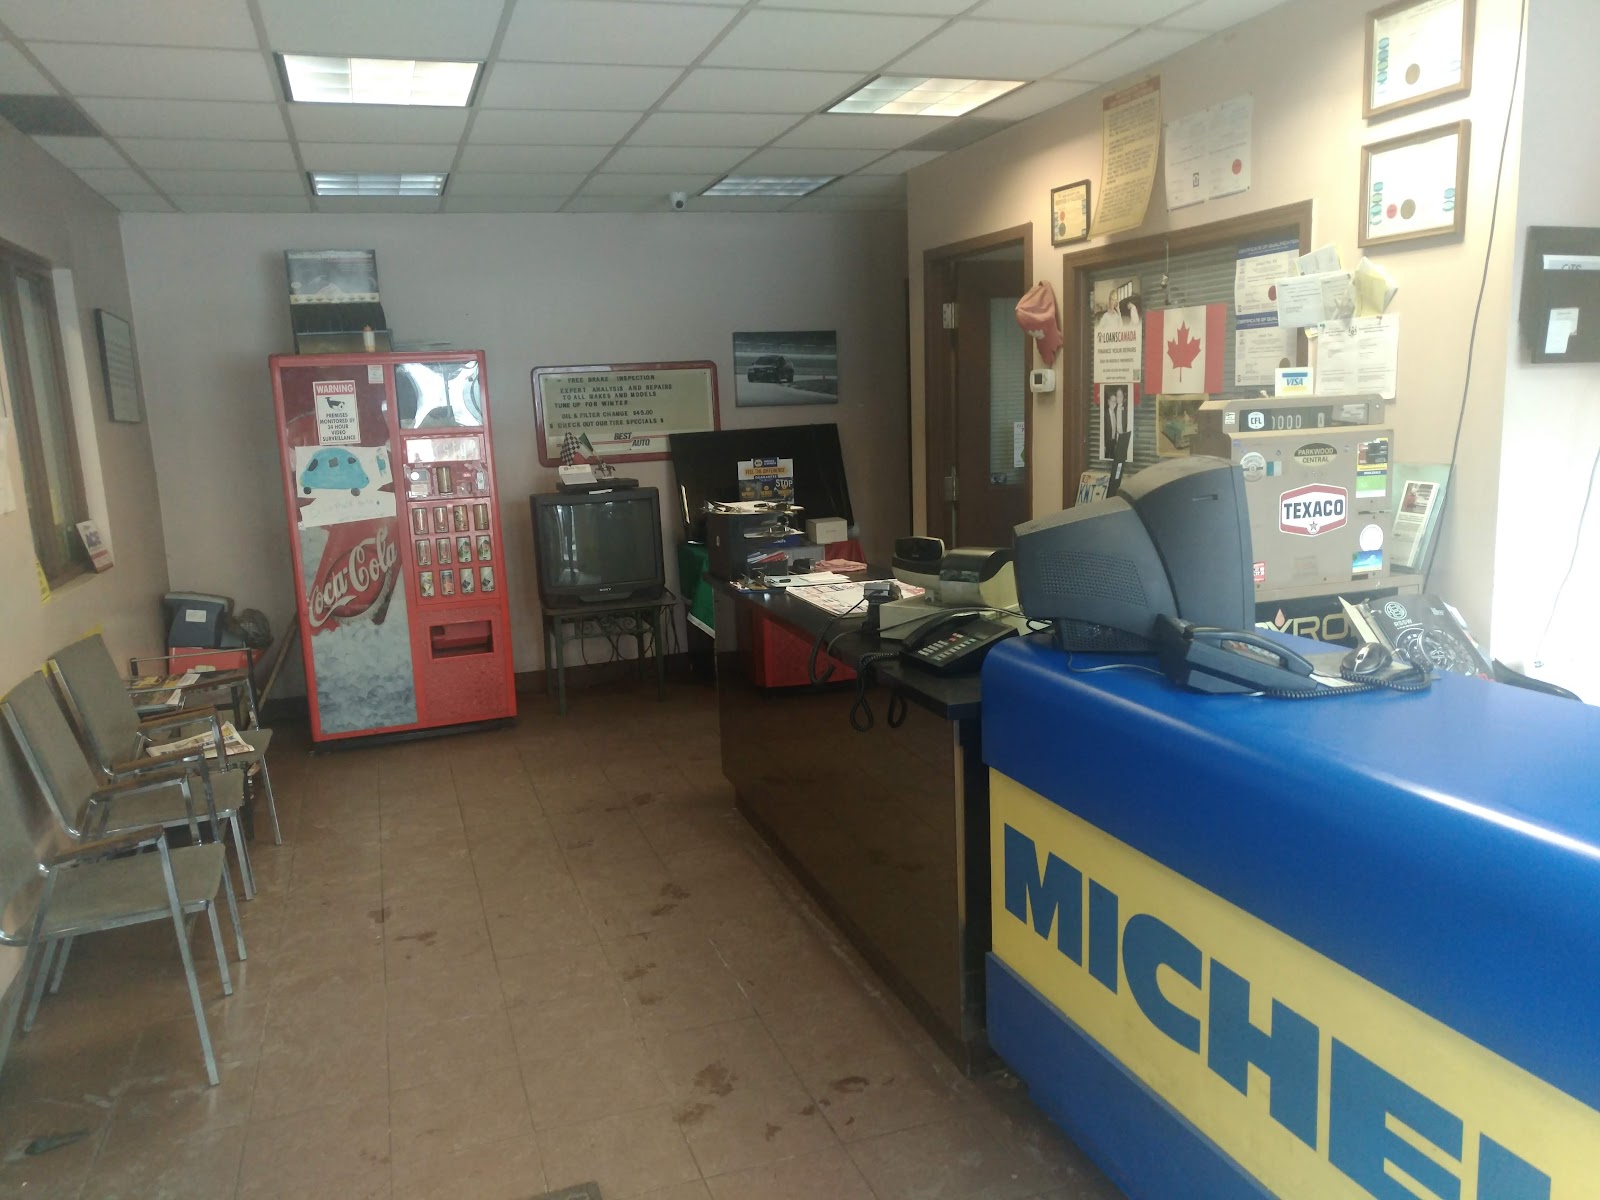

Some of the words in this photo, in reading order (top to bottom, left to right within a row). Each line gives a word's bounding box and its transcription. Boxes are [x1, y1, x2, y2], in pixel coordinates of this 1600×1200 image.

[1286, 378, 1304, 386] VISA
[316, 384, 354, 394] WARNING
[1250, 416, 1262, 425] CFL
[322, 434, 356, 442] SURVEILLANCE
[614, 432, 632, 440] BEST
[632, 438, 650, 446] AUTO
[1297, 447, 1334, 456] PARKWOOD
[1302, 456, 1329, 464] CENTRAL
[775, 478, 793, 487] STOP
[1284, 499, 1344, 520] TEXACO
[308, 526, 397, 626] Coca-Cola
